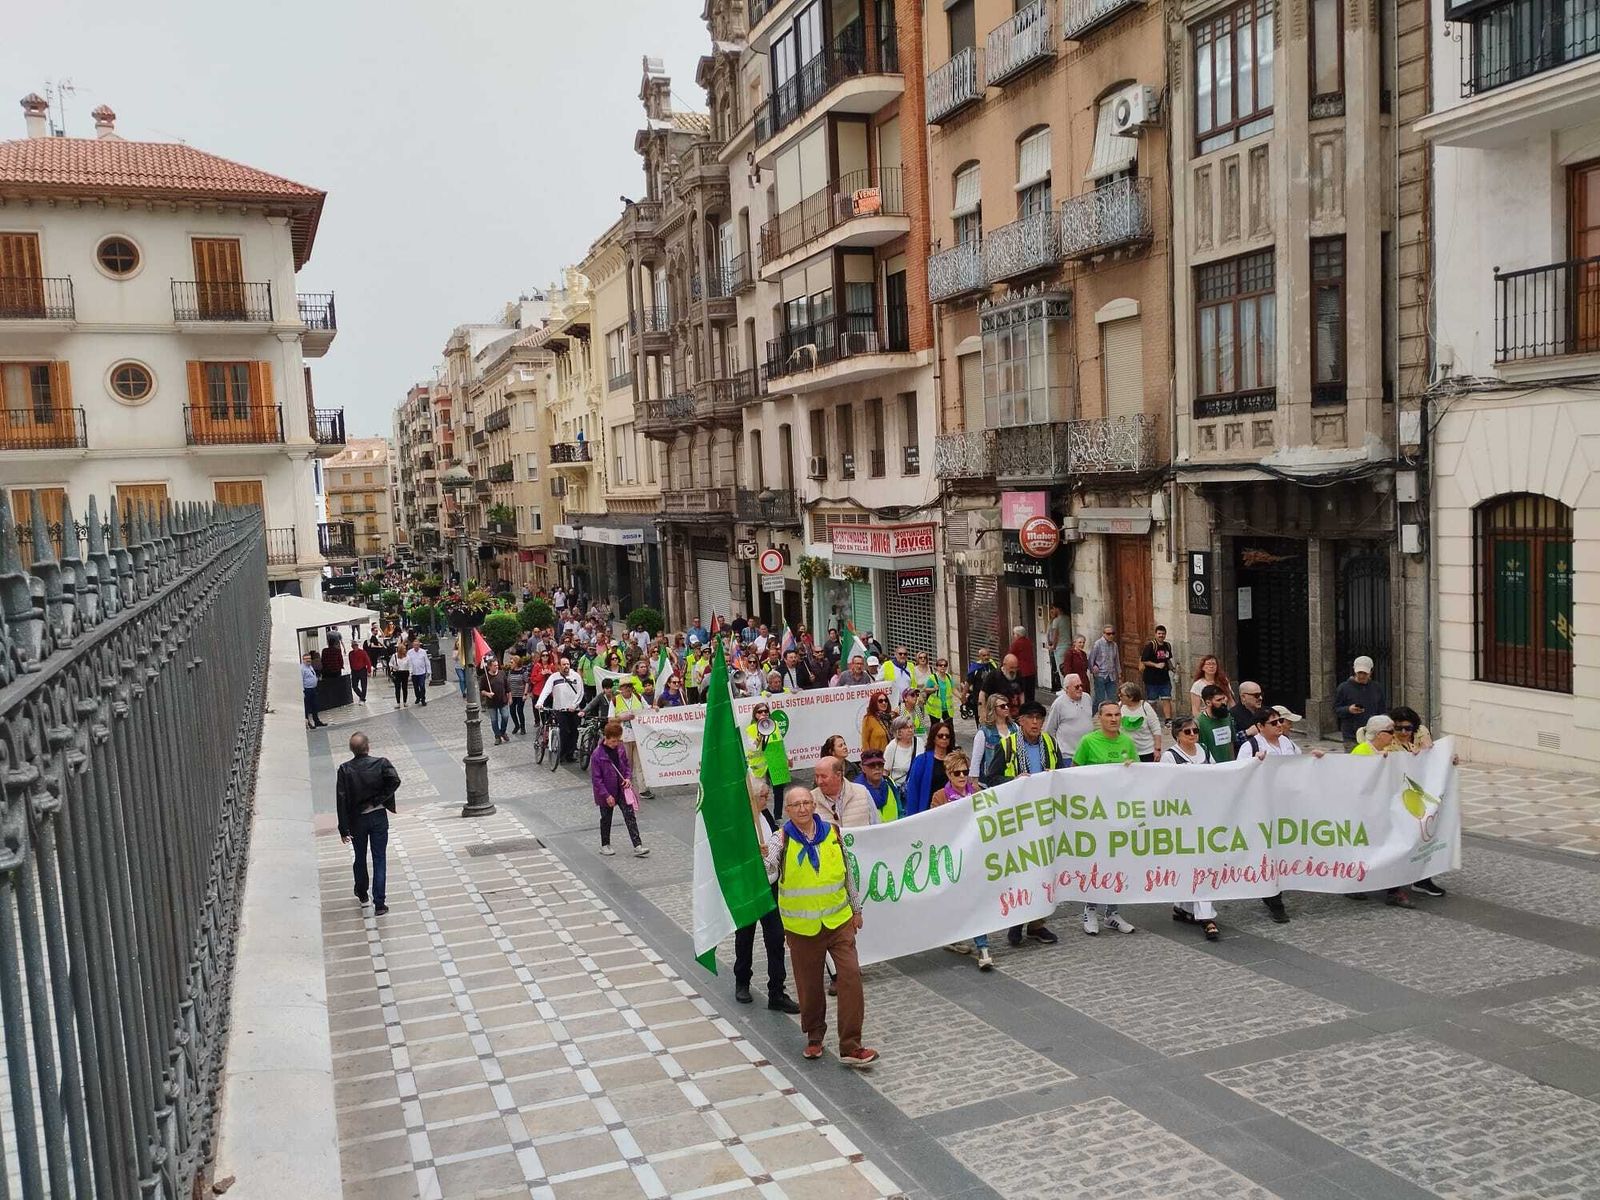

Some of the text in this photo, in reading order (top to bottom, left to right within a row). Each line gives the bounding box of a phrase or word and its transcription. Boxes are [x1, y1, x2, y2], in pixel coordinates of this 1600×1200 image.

[870, 532, 891, 554] JAVIER
[894, 528, 932, 539] OPORTUNIDADES
[896, 535, 932, 549] JAVIER
[901, 577, 930, 587] JAVIER
[772, 699, 785, 709] DEL
[786, 695, 815, 707] SISTEMA
[816, 691, 845, 704] PUBLICO
[847, 689, 856, 699] DE
[638, 710, 706, 724] PLATAFORMA DE LIN
[972, 789, 999, 812] EN
[976, 794, 1193, 844] DEFENSA DE UNA
[984, 831, 1097, 882] SANIDAD
[1108, 822, 1249, 858] PÚBLICA
[999, 887, 1033, 918] sin
[1144, 865, 1182, 892] sin
